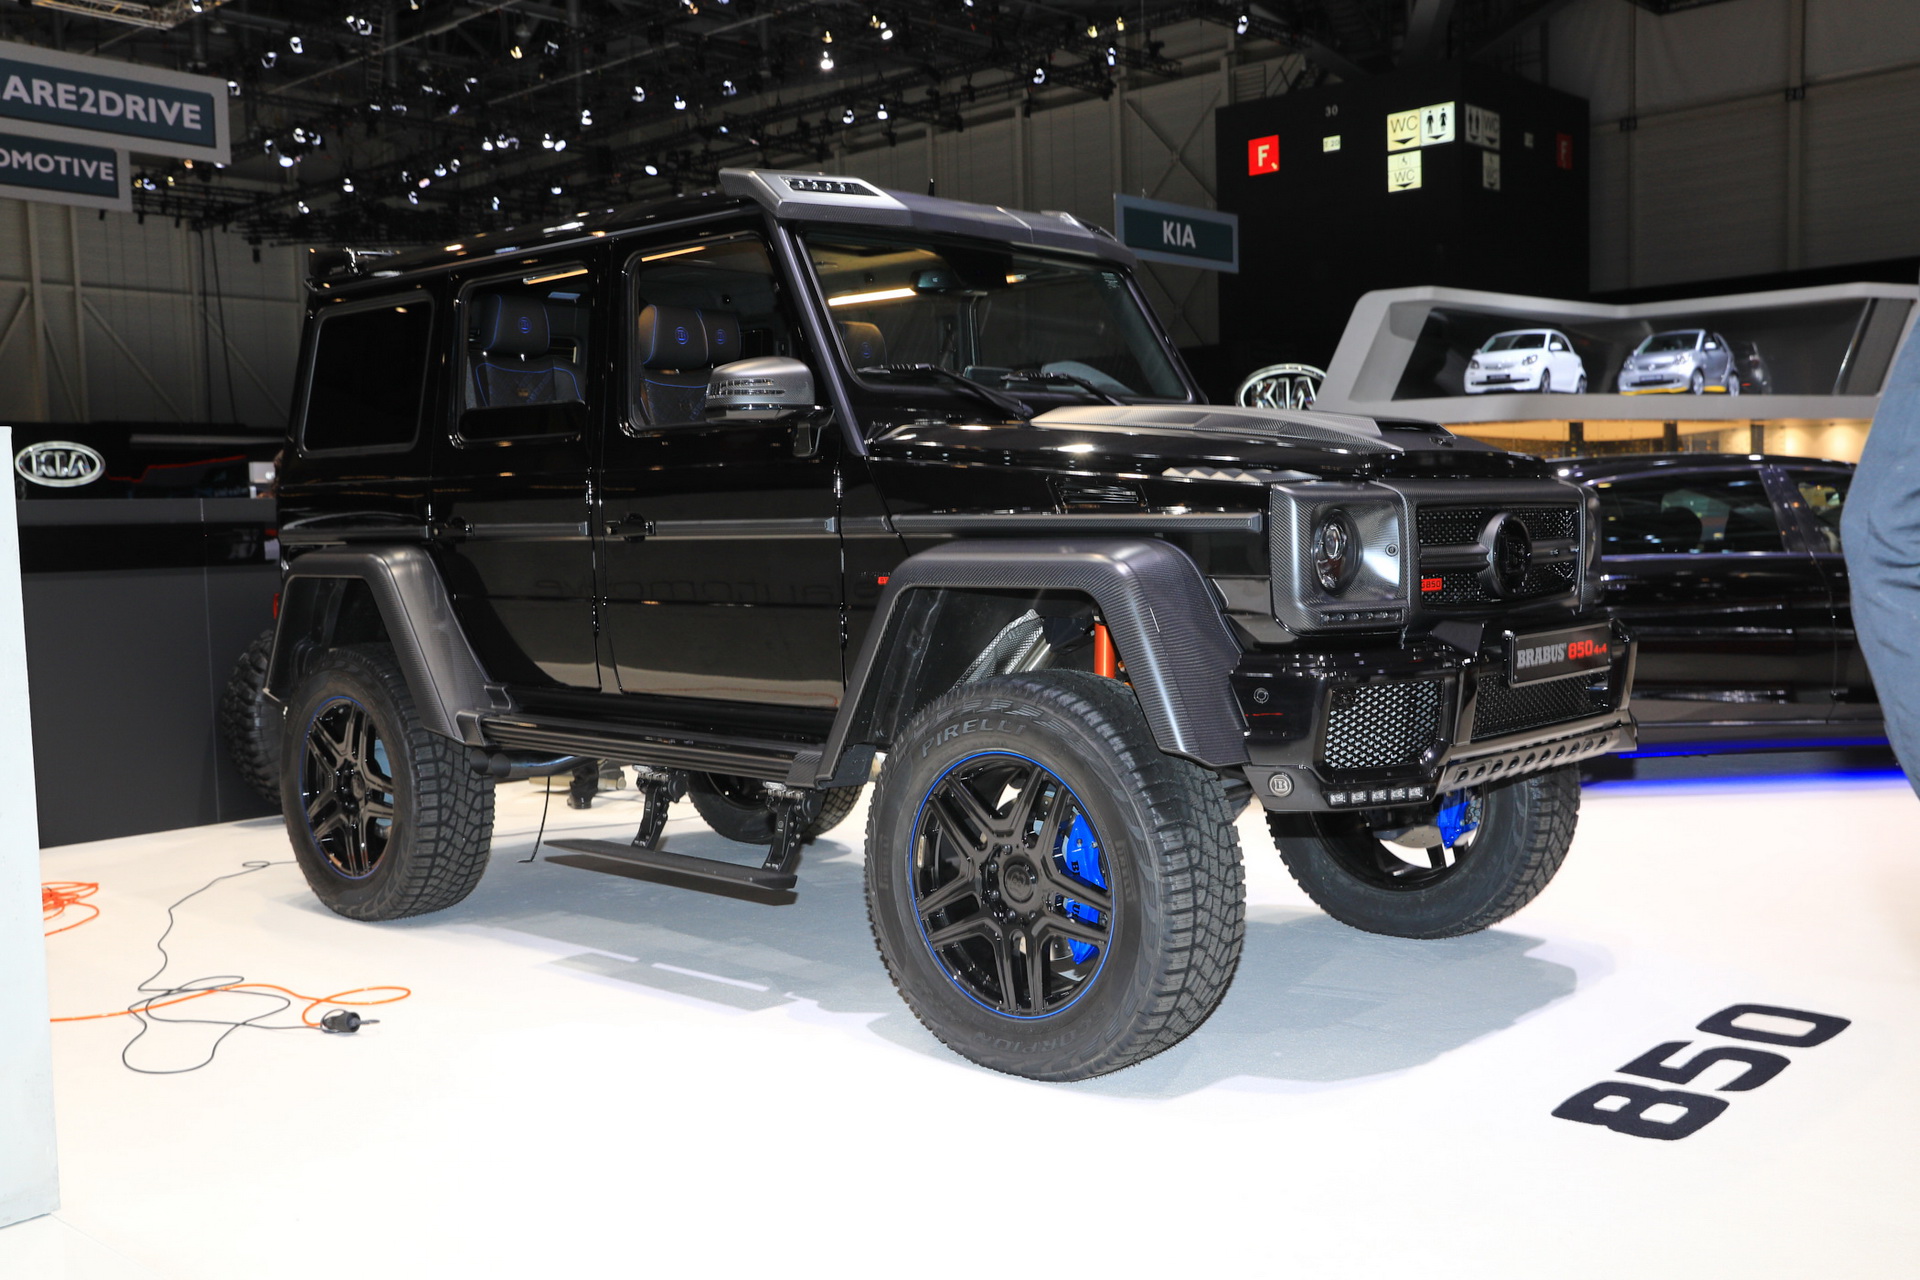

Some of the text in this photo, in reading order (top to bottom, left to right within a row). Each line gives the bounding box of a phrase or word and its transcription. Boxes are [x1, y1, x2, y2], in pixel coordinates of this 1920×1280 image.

[2, 74, 202, 131] ARE2DRIVE
[1389, 115, 1418, 134] WC
[1257, 144, 1270, 167] F
[1393, 170, 1416, 182] WC
[1162, 220, 1196, 249] KIA
[31, 450, 92, 478] KIA
[1516, 643, 1566, 669] BRABUS
[1567, 639, 1593, 660] 850
[921, 718, 1027, 758] PIRELLI
[1550, 1002, 1852, 1141] 850
